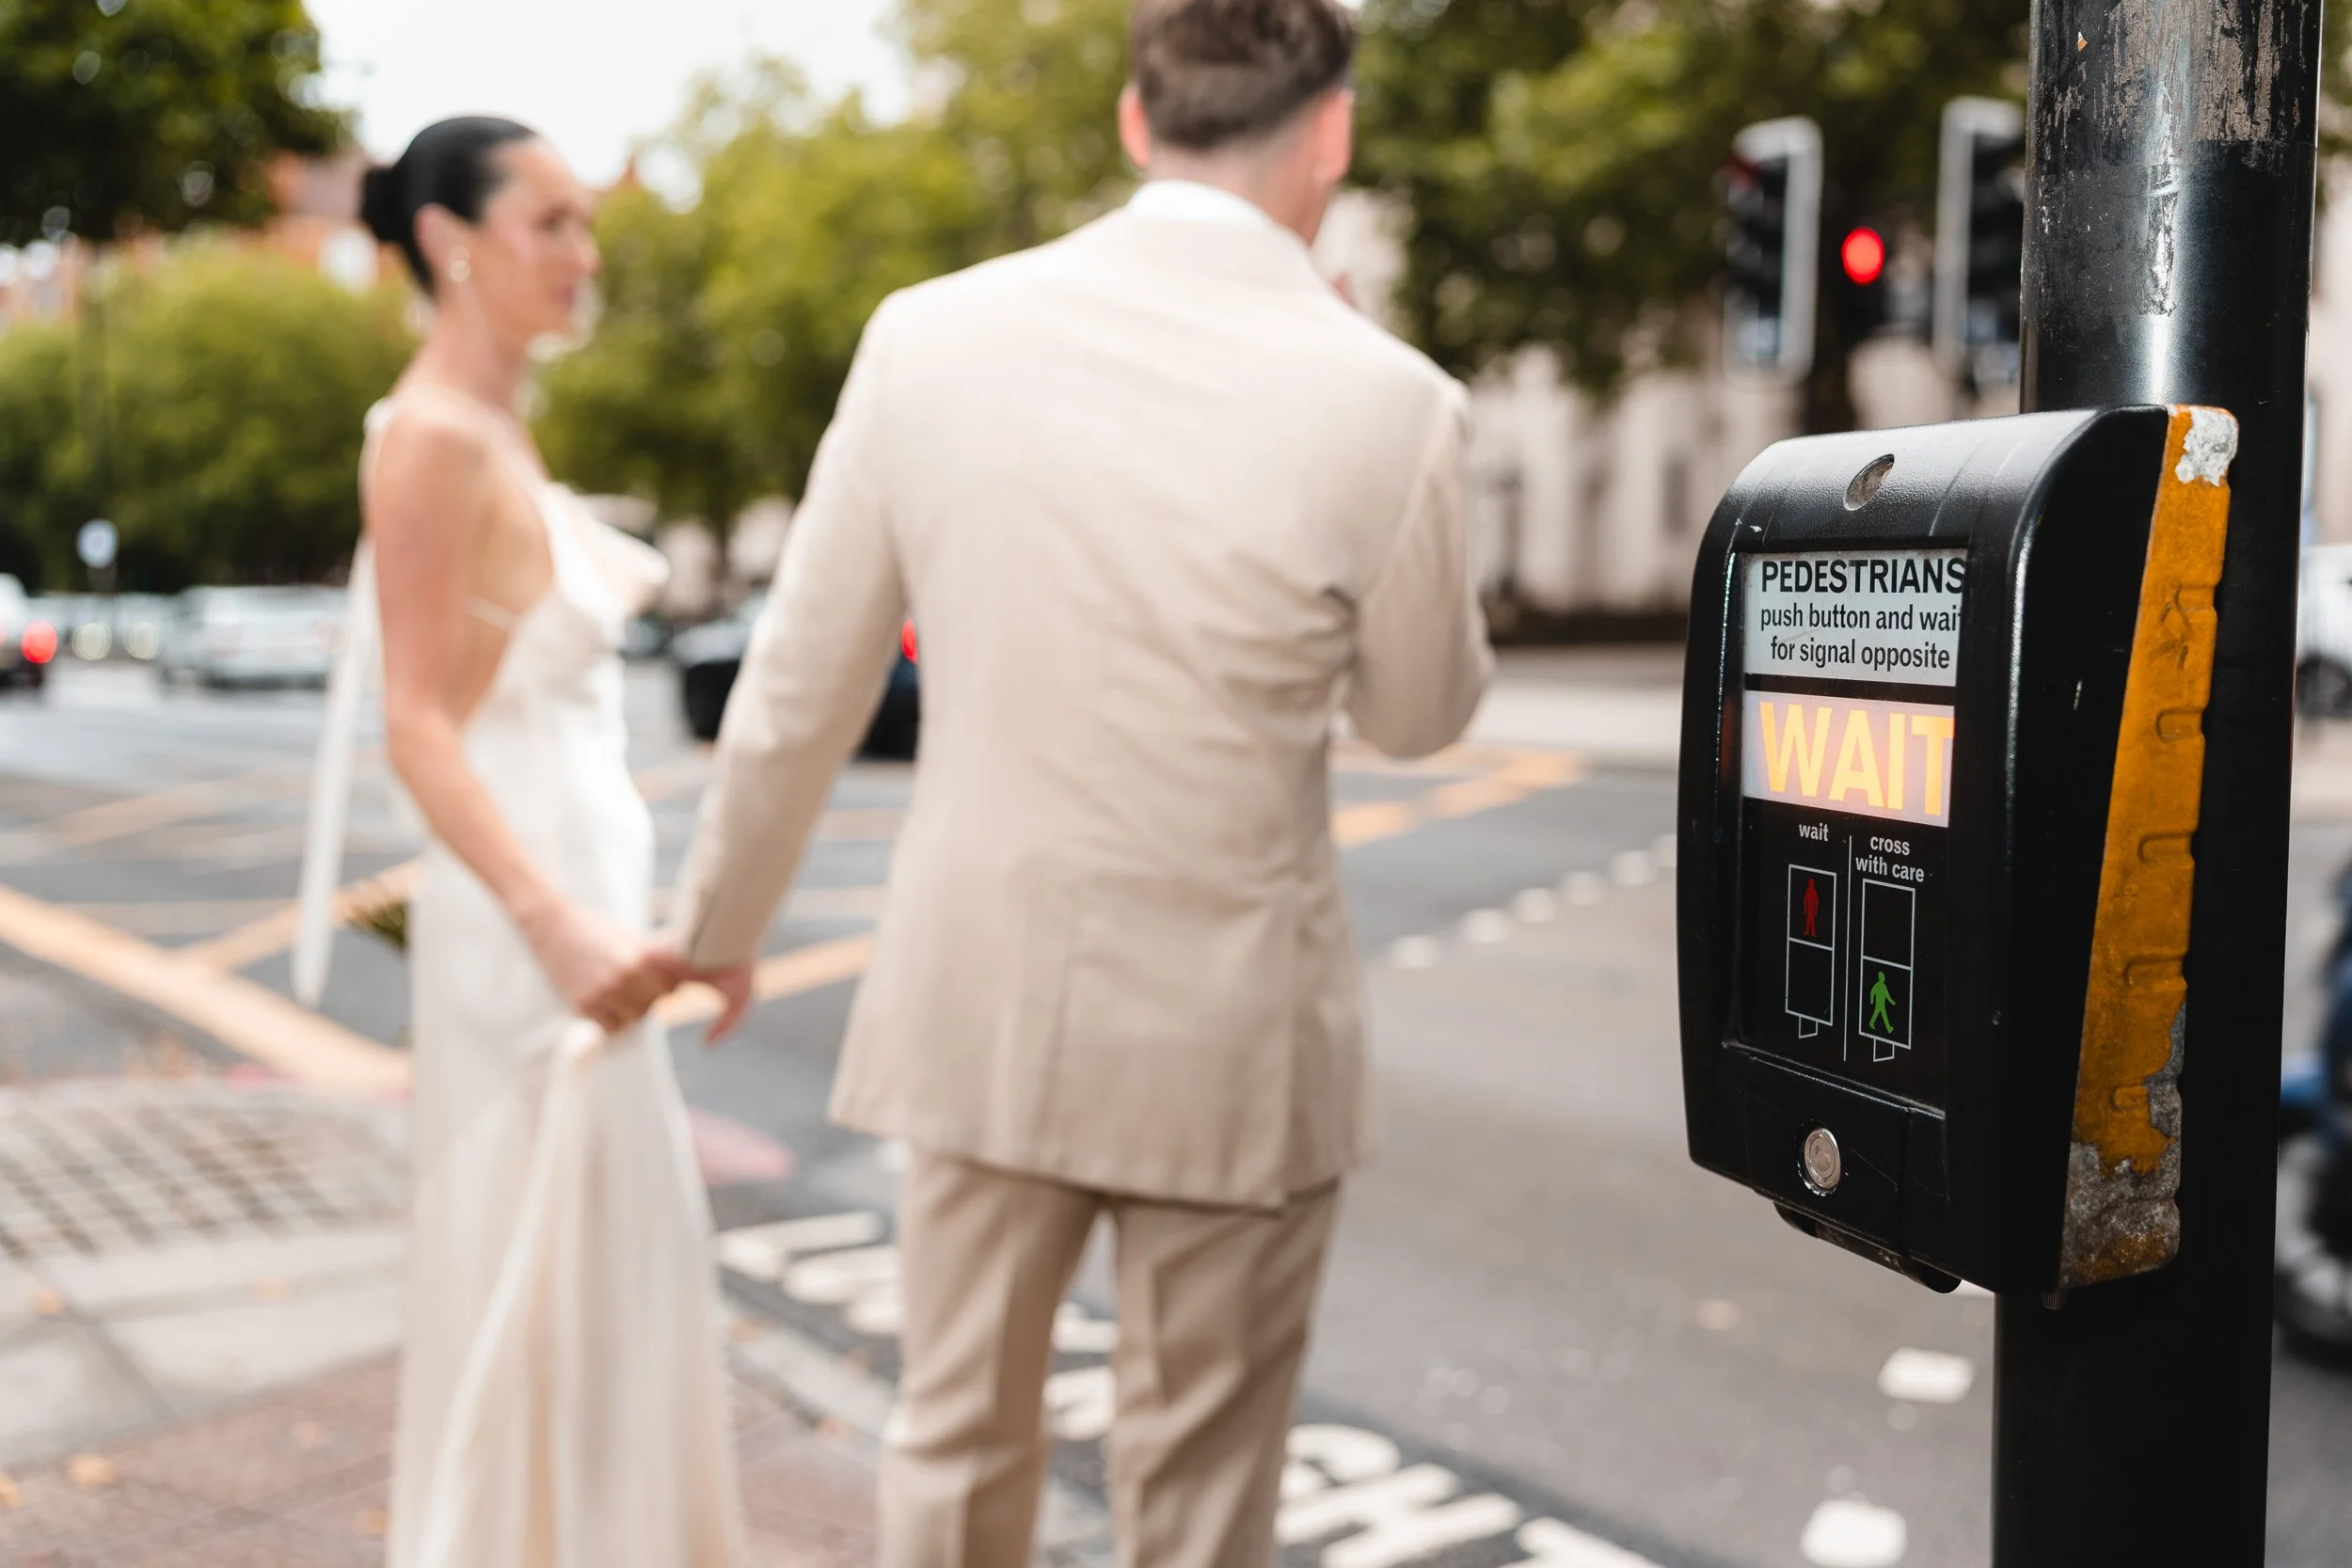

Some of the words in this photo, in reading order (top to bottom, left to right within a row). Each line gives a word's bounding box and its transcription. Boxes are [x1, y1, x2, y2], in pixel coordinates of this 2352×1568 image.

[1761, 557, 1964, 594] PEDESTRIANS
[1760, 603, 1804, 630] push
[1809, 603, 1869, 628] button
[1876, 604, 1913, 629] and
[1919, 605, 1961, 631] wai
[1771, 636, 1795, 659] for
[1800, 638, 1855, 668] signal
[1861, 641, 1949, 672] opposite
[1759, 701, 1955, 816] WAIT
[1799, 823, 1829, 842] wait
[1870, 835, 1911, 855] cross
[1855, 855, 1888, 876] with
[1892, 863, 1925, 883] care
